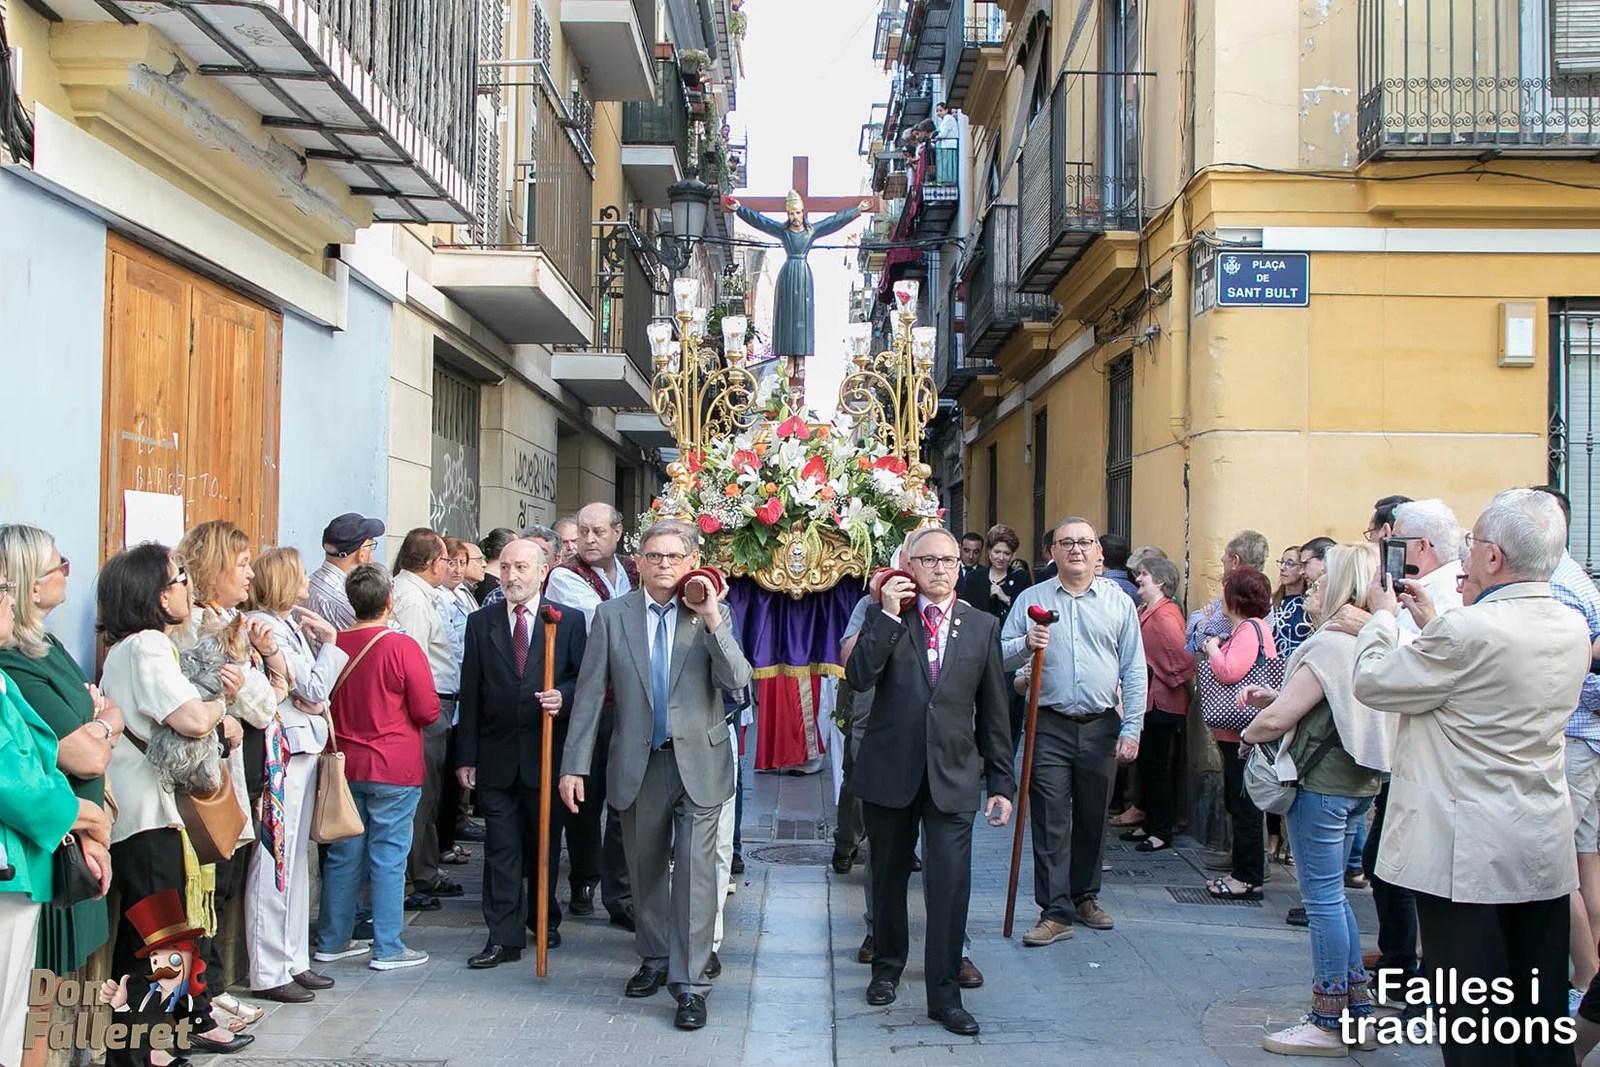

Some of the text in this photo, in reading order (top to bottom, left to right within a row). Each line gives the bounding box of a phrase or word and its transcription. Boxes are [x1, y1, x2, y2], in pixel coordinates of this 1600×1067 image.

[1252, 260, 1286, 271] PLAÇA
[1256, 274, 1270, 282] DE
[1227, 287, 1299, 299] SANT BULT
